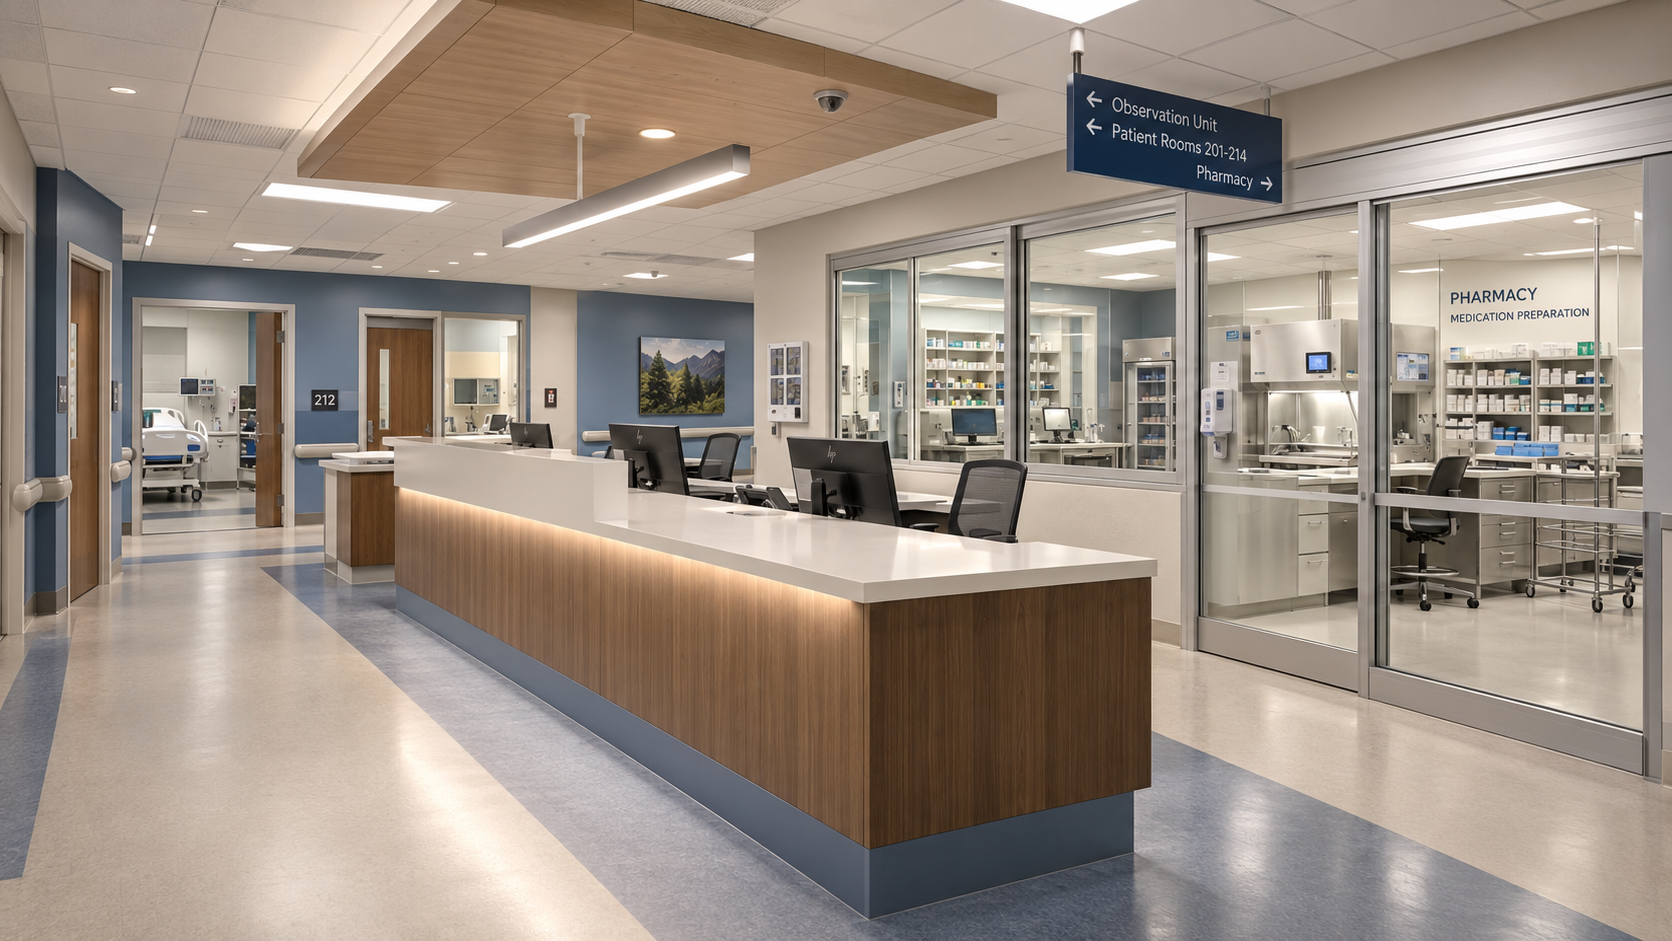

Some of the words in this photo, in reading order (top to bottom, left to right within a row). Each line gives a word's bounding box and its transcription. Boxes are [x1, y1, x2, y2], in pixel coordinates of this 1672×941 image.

[1112, 97, 1190, 127] Observation
[1193, 114, 1218, 133] Unit
[1112, 123, 1157, 147] Patient
[1161, 133, 1201, 154] Rooms
[1204, 142, 1247, 163] 201-214
[1197, 164, 1253, 191] Pharmacy
[1450, 287, 1538, 305] PHARMACY
[1450, 311, 1514, 323] MEDICATION
[1517, 308, 1590, 321] PREPARATION
[314, 394, 336, 406] 212
